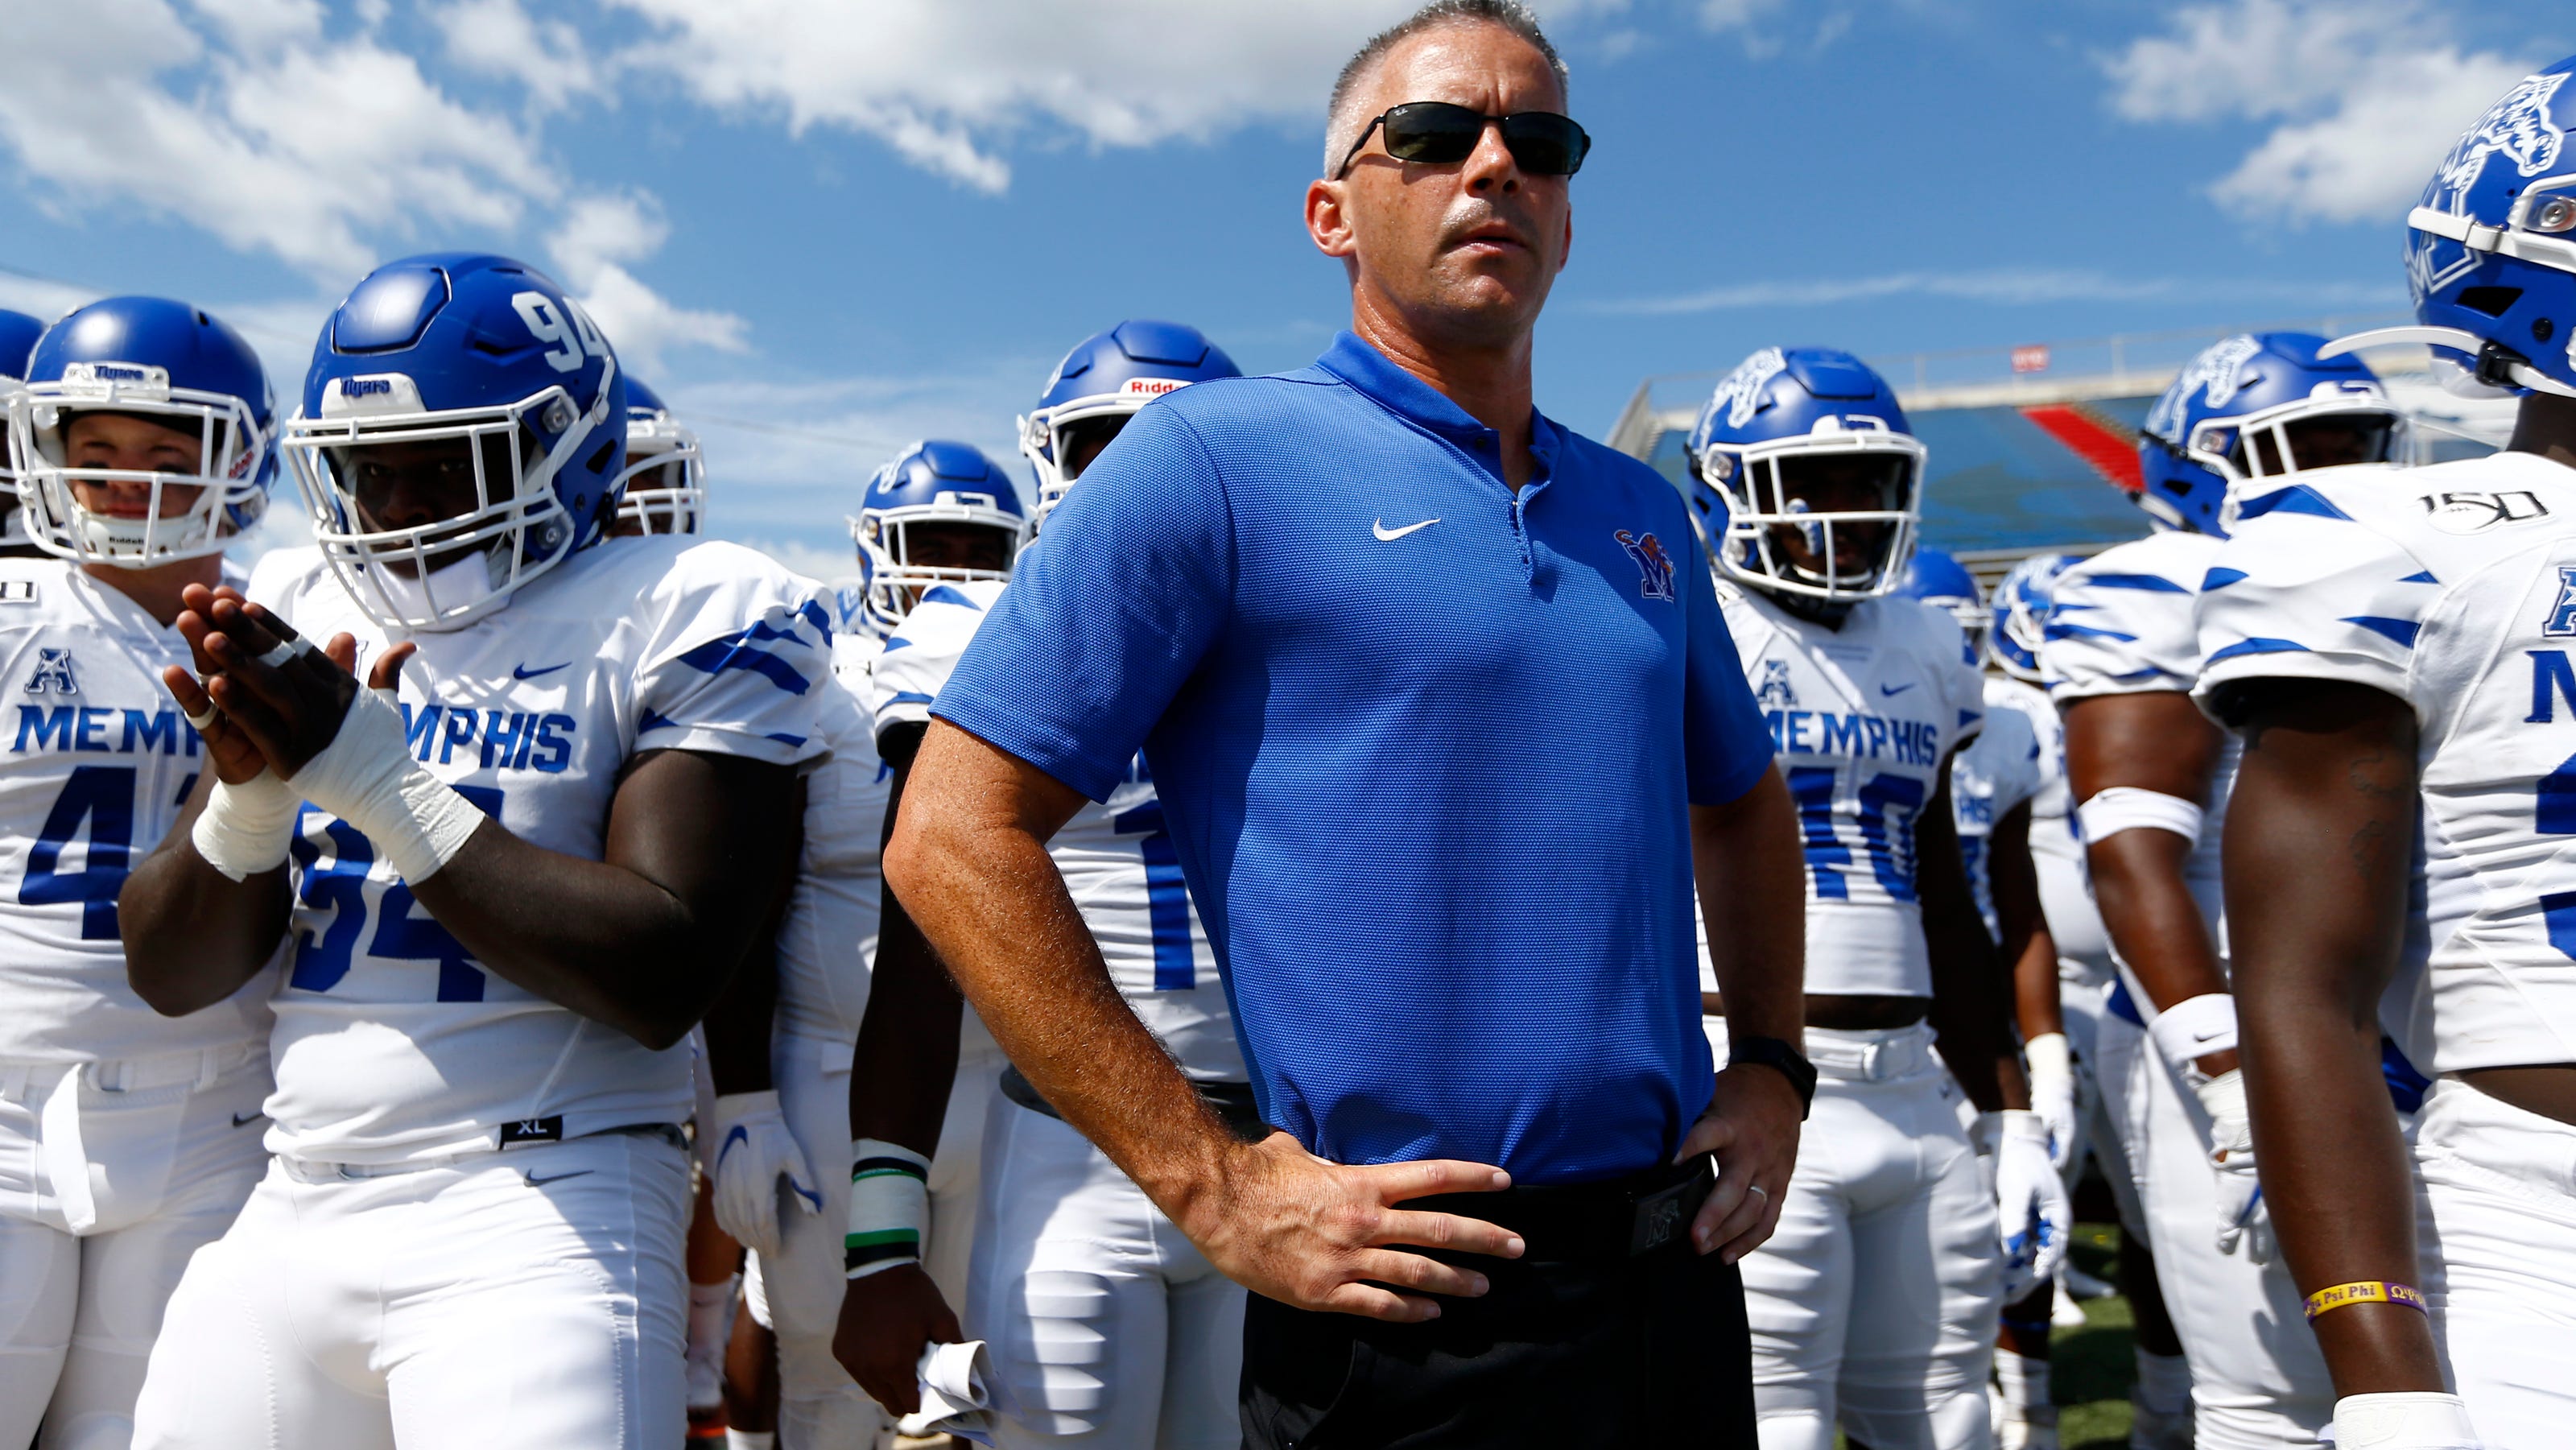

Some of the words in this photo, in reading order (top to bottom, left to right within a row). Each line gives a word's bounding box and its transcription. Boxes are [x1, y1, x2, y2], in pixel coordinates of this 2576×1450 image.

[512, 291, 611, 373] 94
[1131, 381, 1181, 394] Ridd
[400, 702, 576, 774] MPHIS
[517, 1120, 548, 1134] XL
[2323, 1288, 2344, 1304] Psi
[2348, 1285, 2376, 1298] Phi
